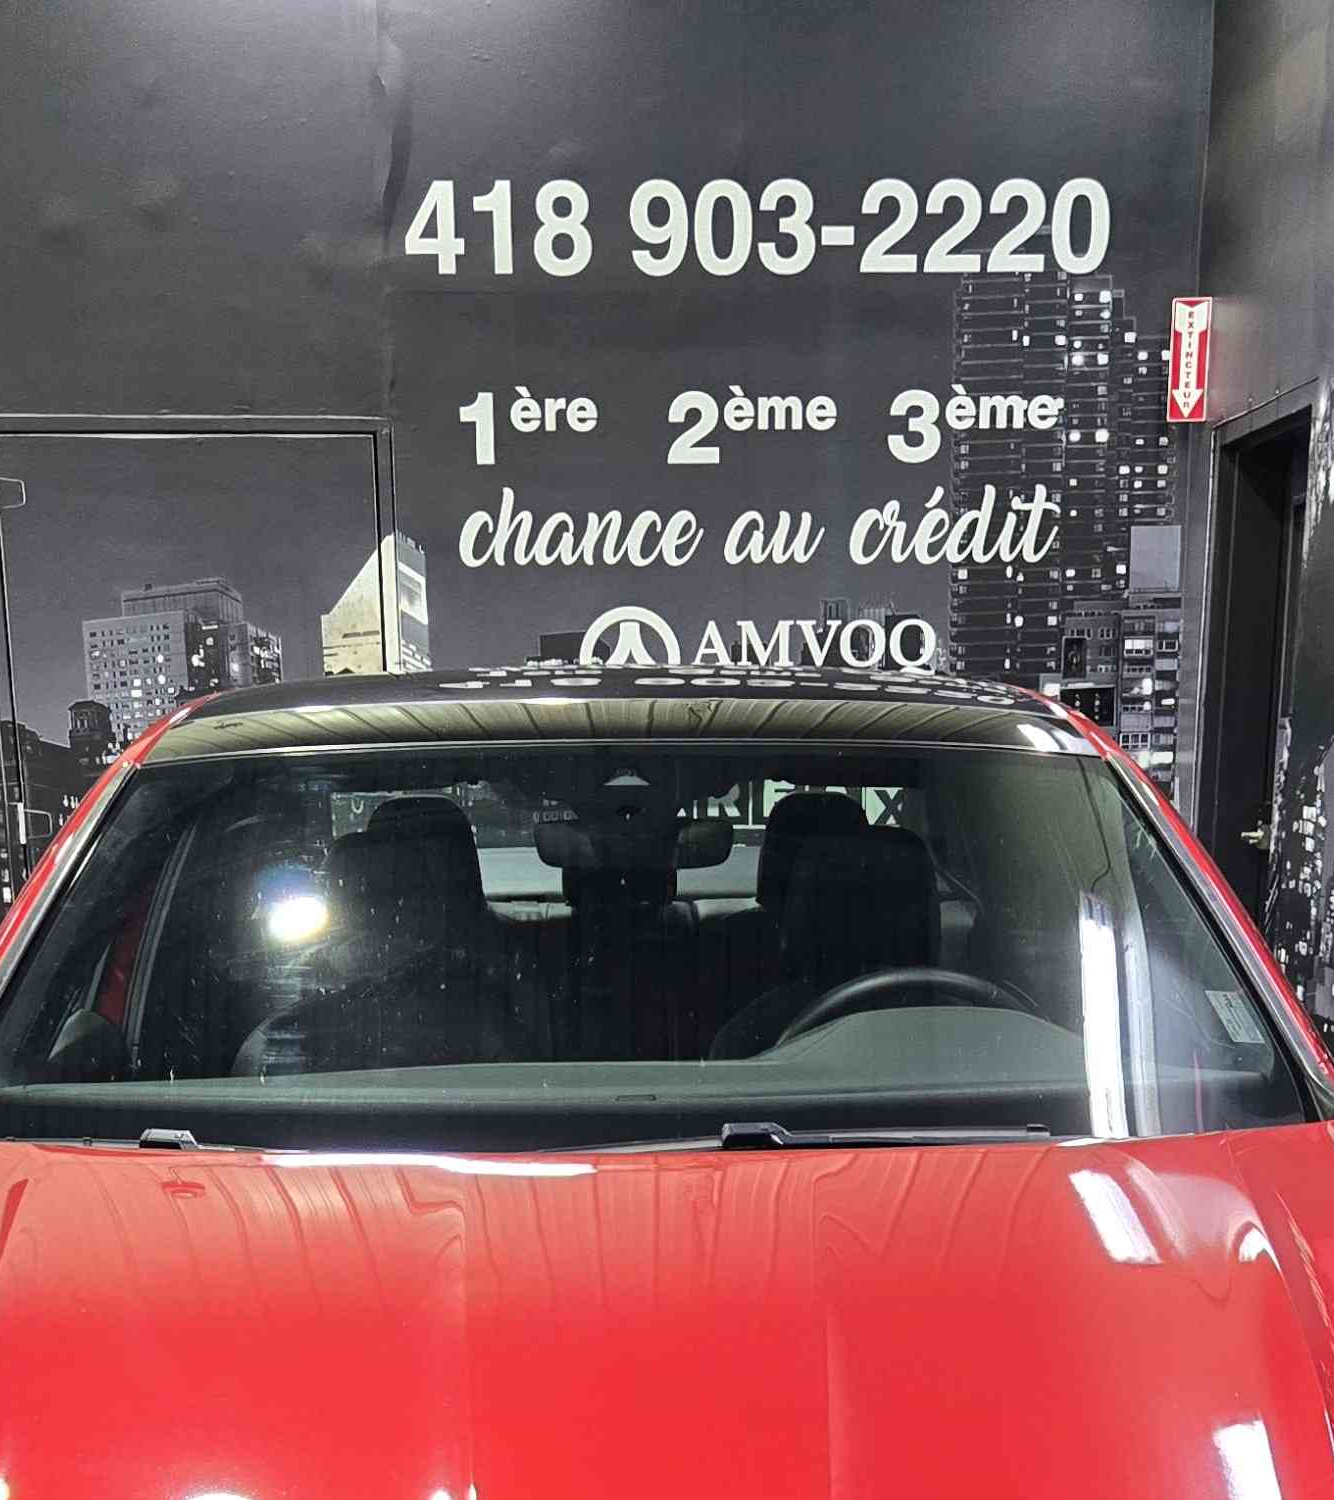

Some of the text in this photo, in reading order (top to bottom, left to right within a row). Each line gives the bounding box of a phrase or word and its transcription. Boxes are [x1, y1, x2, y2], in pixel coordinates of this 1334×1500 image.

[405, 178, 1111, 276] 418 903-2220
[1182, 311, 1194, 408] EXTINCTEUR
[459, 484, 1061, 568] chance au crédit
[694, 620, 937, 676] AMVOQ
